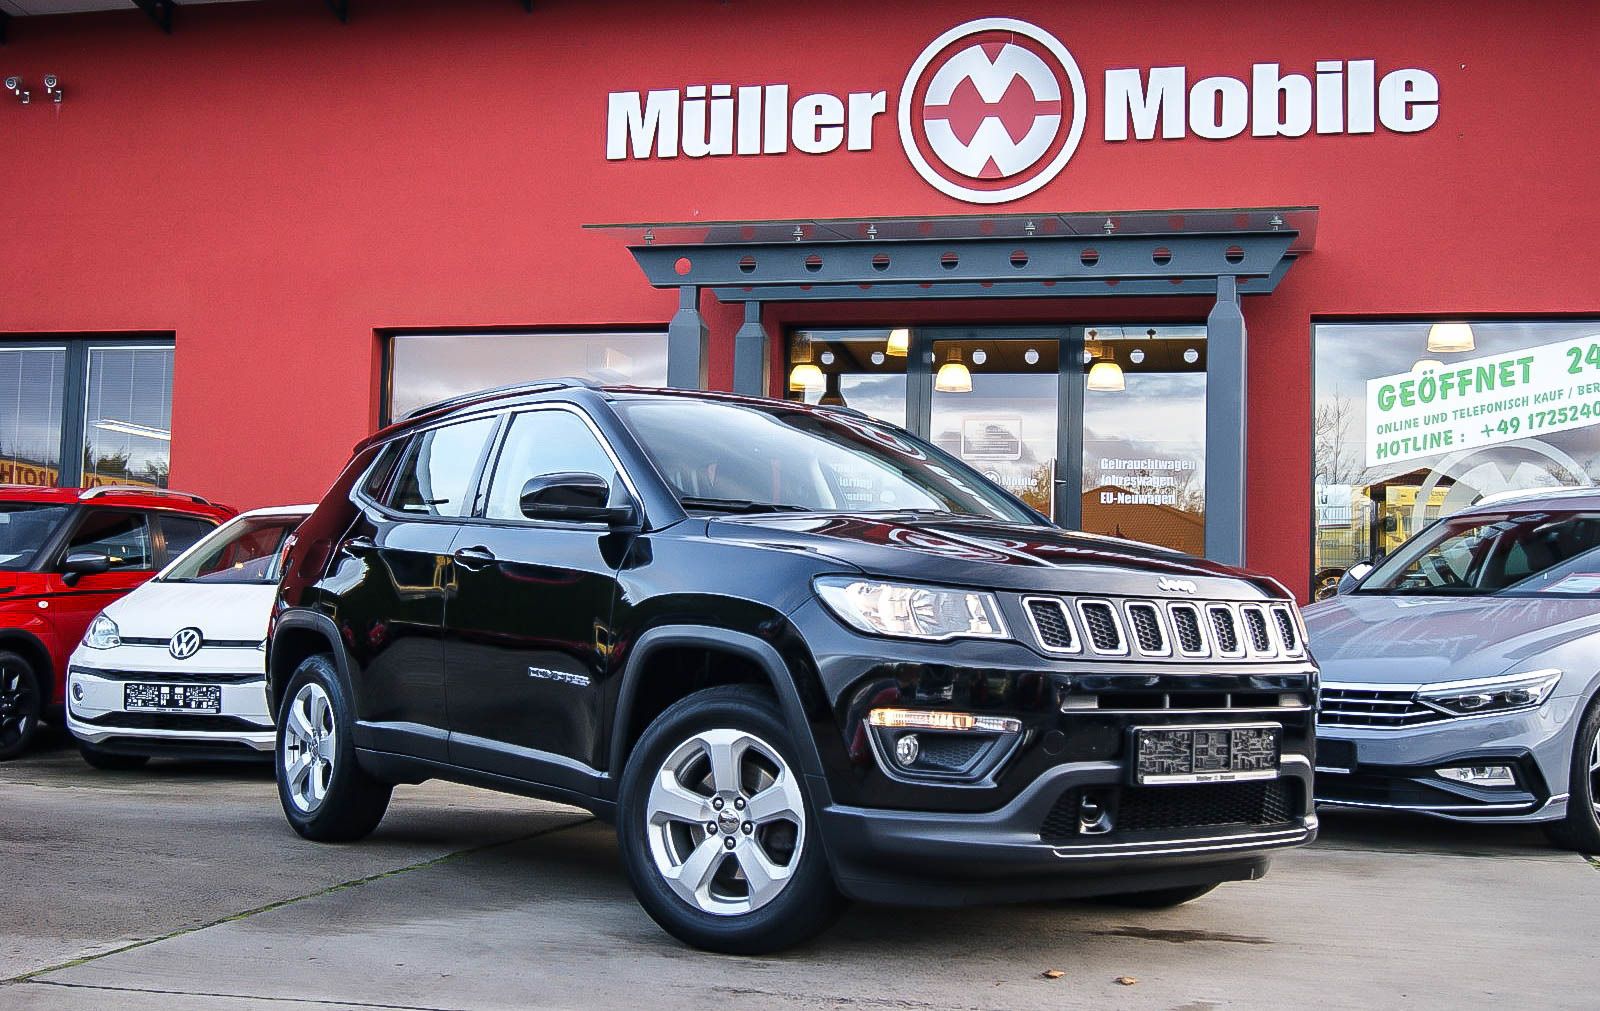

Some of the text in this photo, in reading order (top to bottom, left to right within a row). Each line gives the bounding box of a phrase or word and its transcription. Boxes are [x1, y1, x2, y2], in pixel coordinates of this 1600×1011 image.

[606, 59, 1439, 160] Müller Mobile
[1376, 343, 1600, 412] GEÖFFNET 24
[1376, 417, 1420, 435] ONLINE
[1423, 412, 1448, 426] UND
[1452, 397, 1529, 421] TELEFONISCH
[1533, 388, 1565, 404] KAUF
[1567, 386, 1573, 399] /
[1376, 429, 1454, 460] HOTLINE
[1480, 416, 1521, 438] +49
[1527, 400, 1600, 430] 1725240
[1100, 492, 1176, 505] EU-Neuwagen
